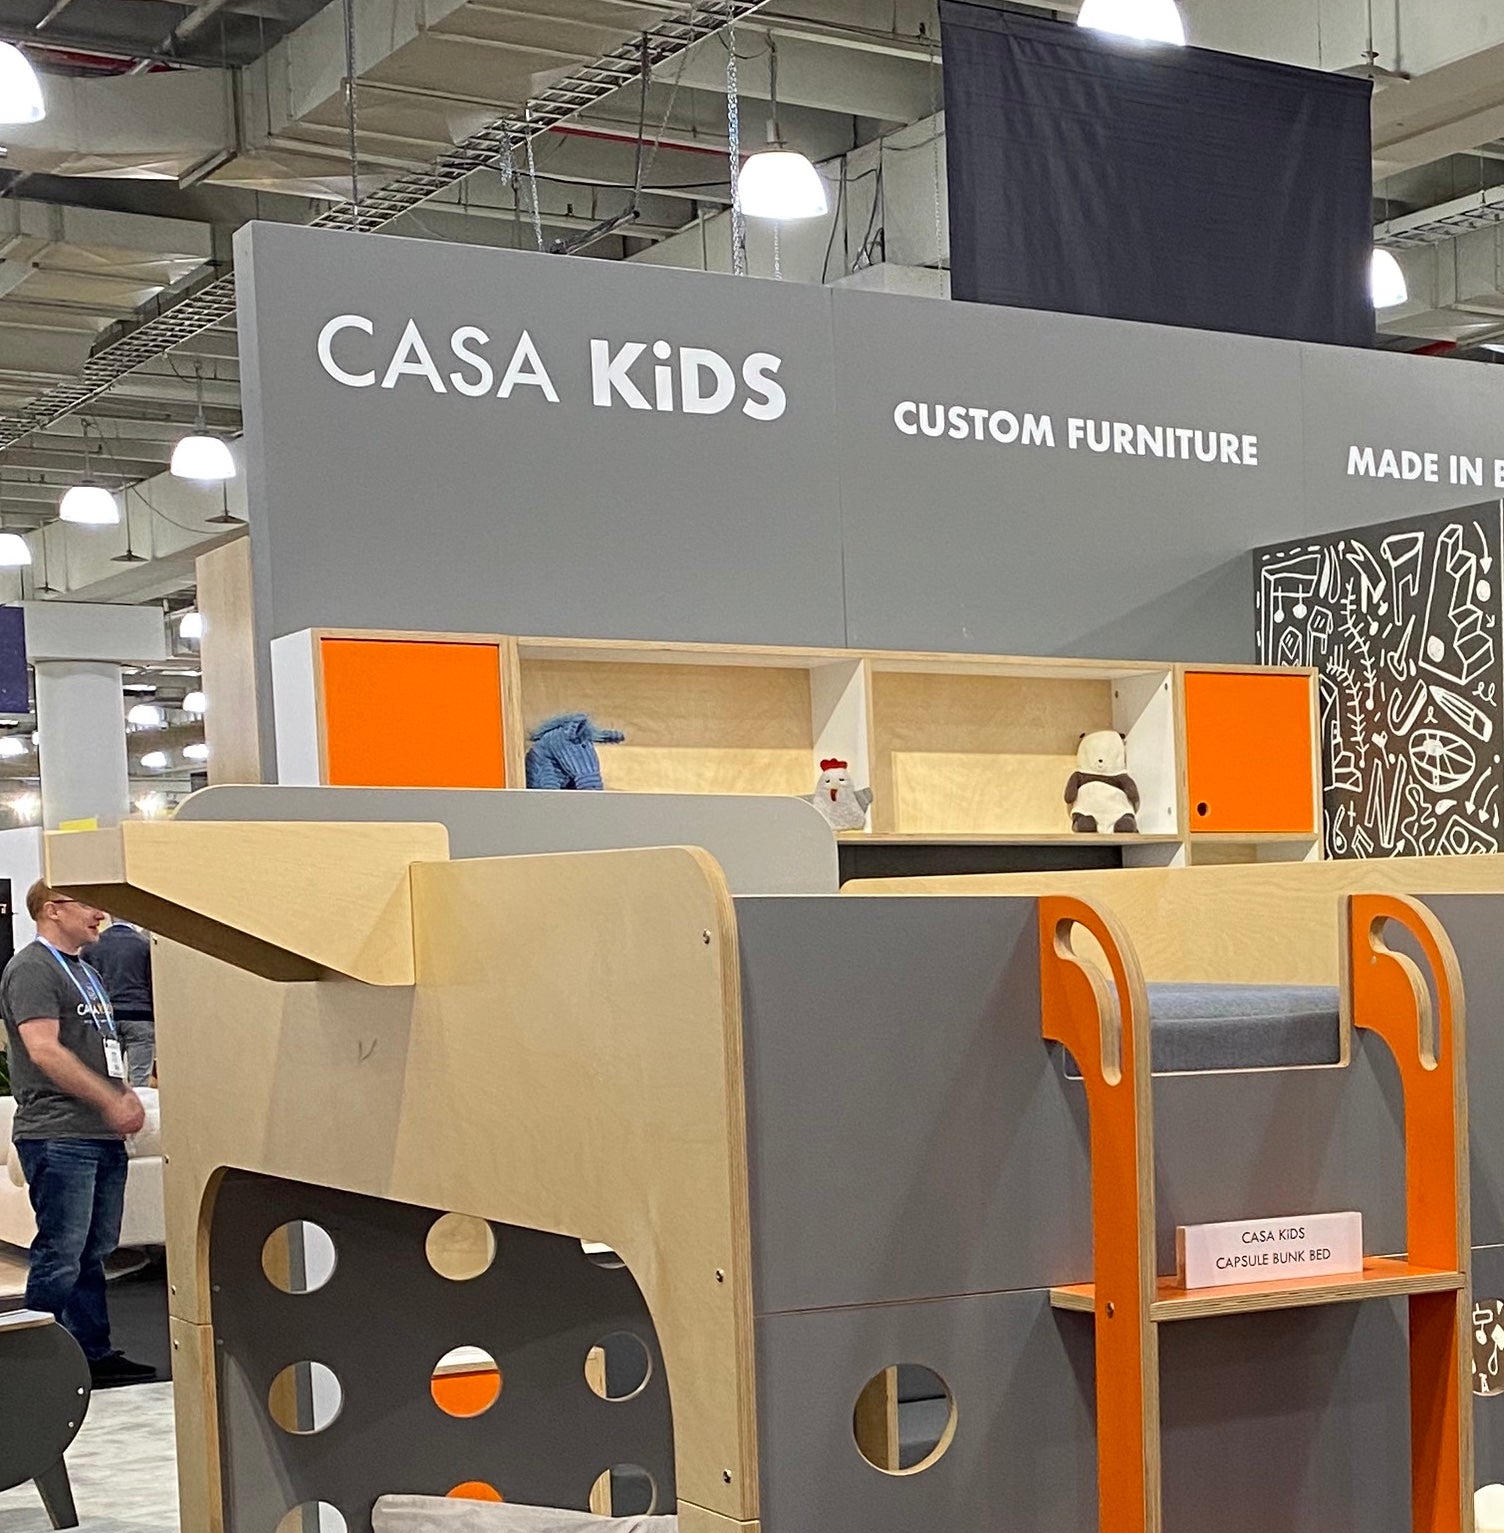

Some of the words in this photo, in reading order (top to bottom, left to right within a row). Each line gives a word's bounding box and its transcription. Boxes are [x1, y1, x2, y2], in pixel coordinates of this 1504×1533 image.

[316, 314, 560, 405] CASA
[590, 339, 788, 422] KiDS
[893, 400, 1056, 448] CUSTOM
[1067, 417, 1259, 466] FURNITURE
[1347, 445, 1439, 482] MADE
[1449, 454, 1484, 486] IN
[1241, 1229, 1275, 1244] CASA
[1215, 1253, 1269, 1270] CAPSULE
[1272, 1249, 1306, 1264] BUNK
[1309, 1248, 1331, 1262] BED
